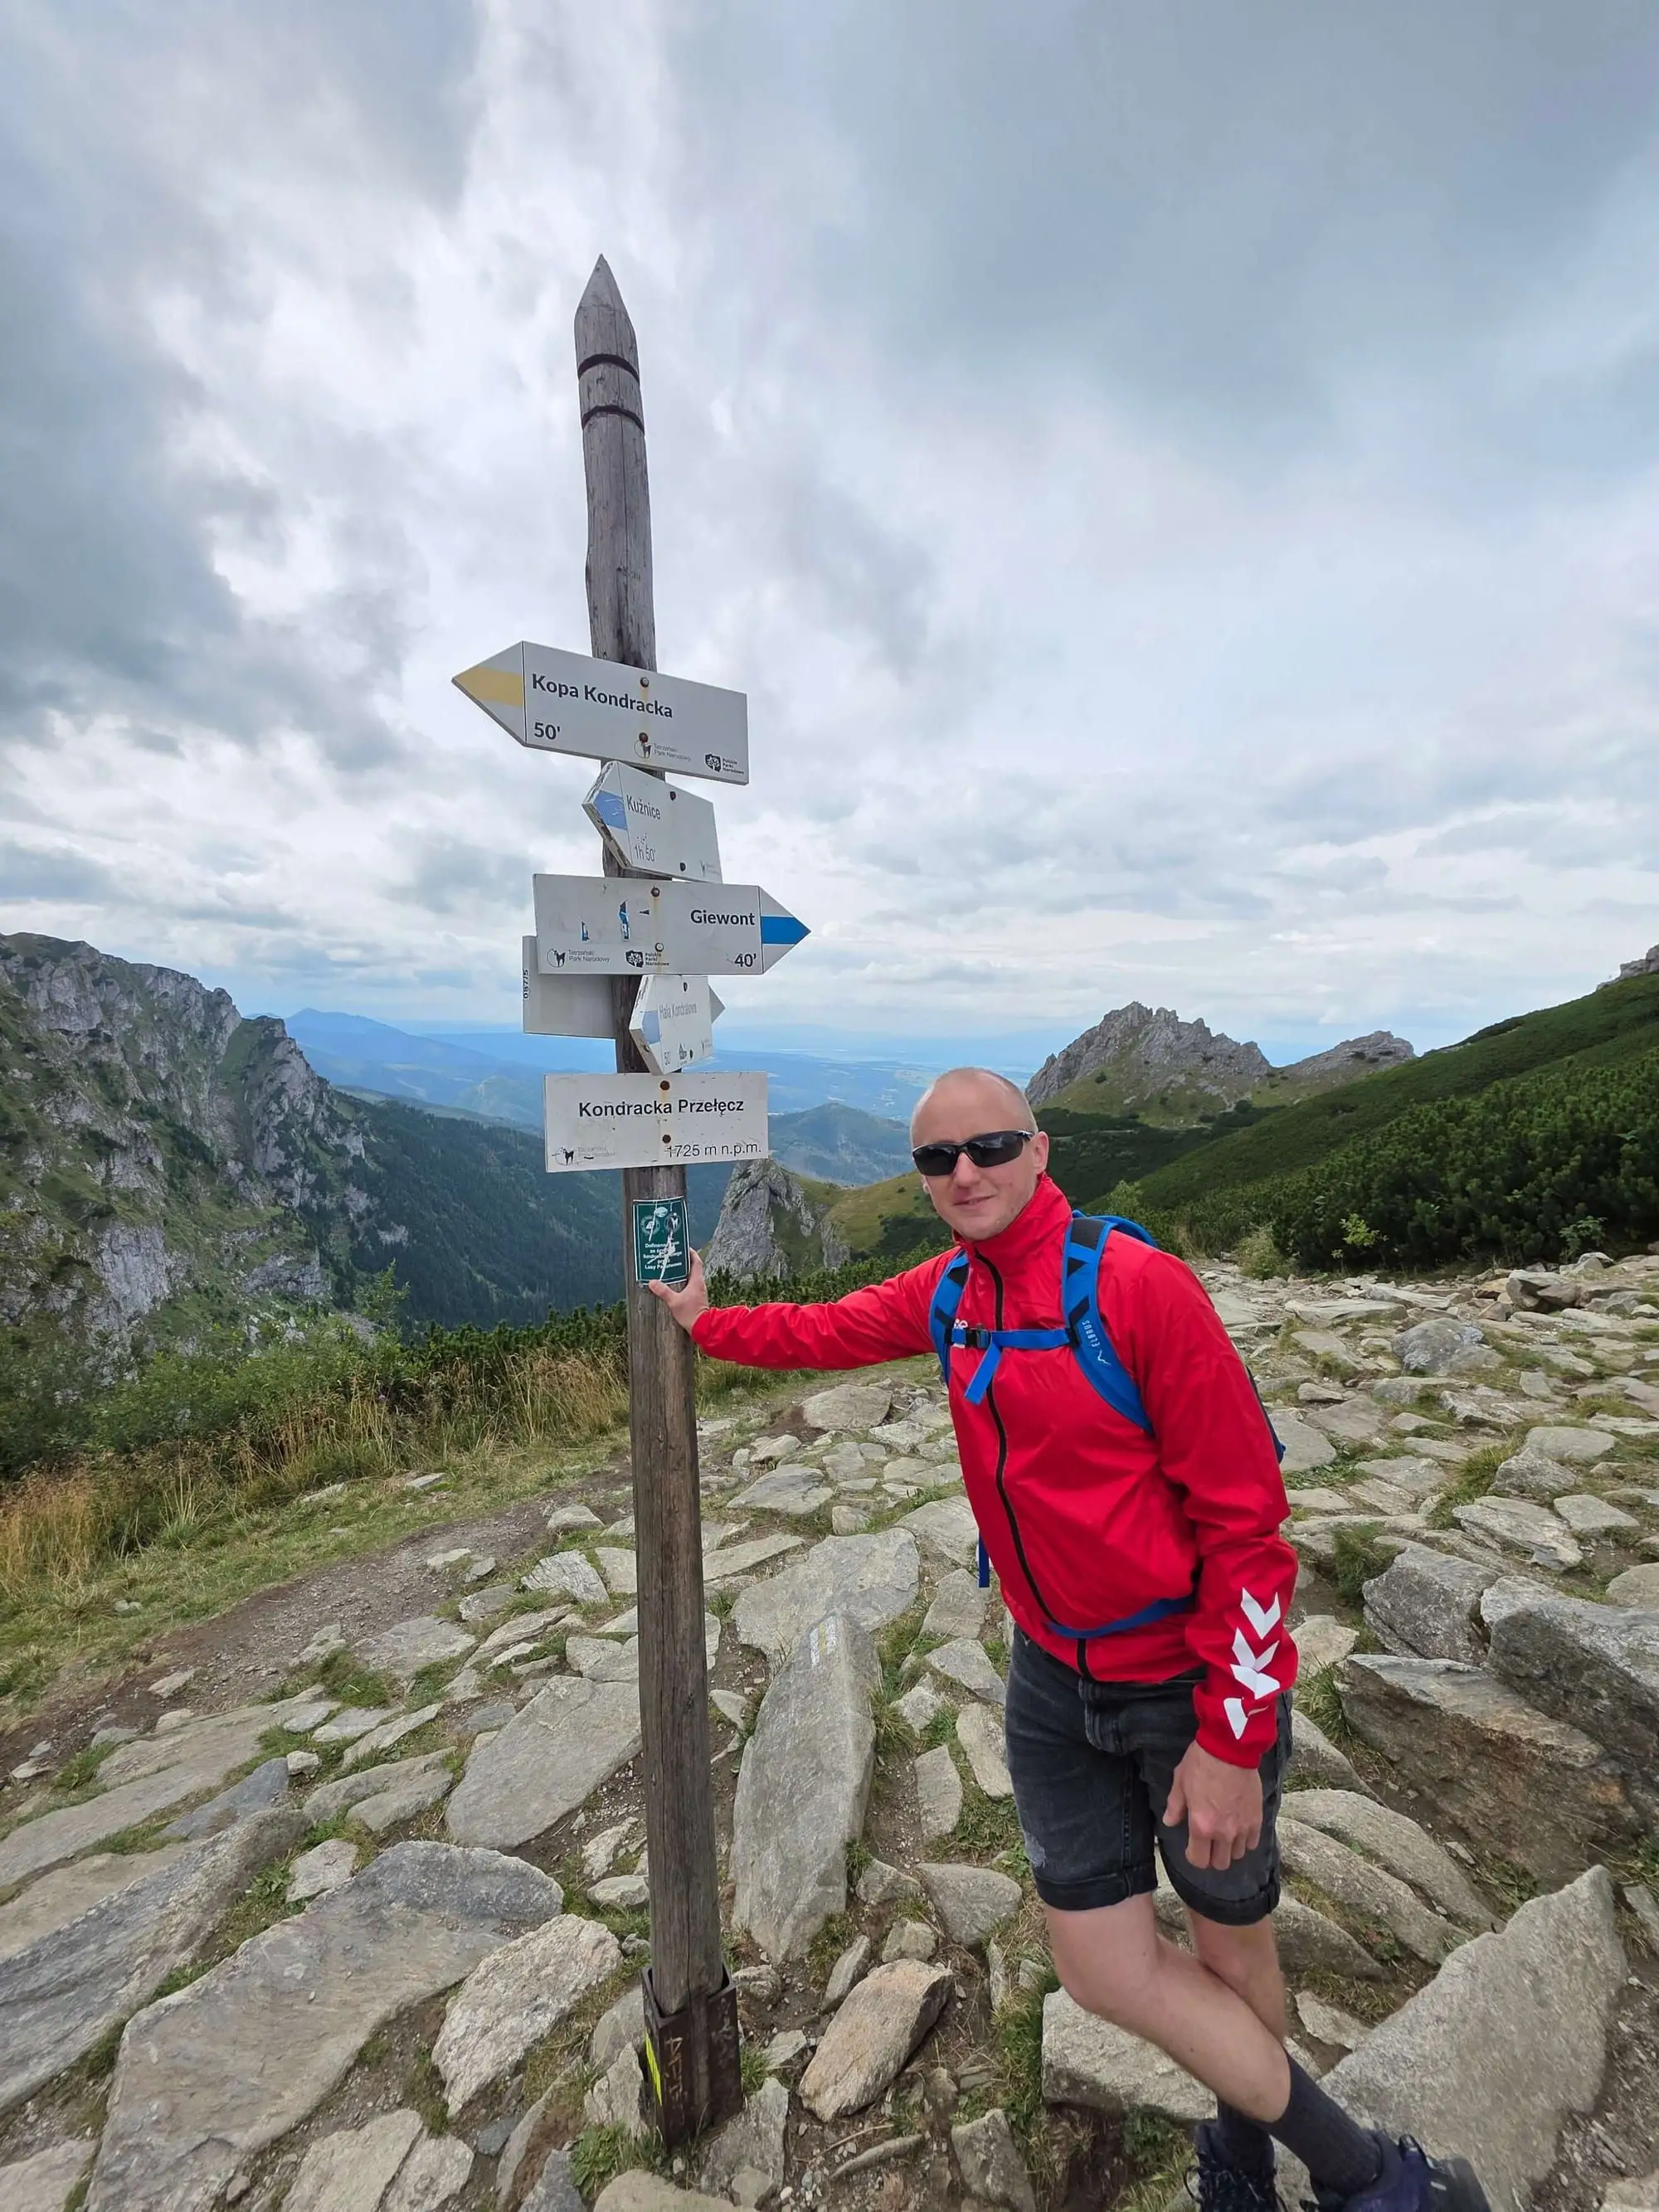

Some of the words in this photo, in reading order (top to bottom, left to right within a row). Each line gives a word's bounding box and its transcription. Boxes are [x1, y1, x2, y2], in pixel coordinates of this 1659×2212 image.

[532, 673, 579, 698] Kopa
[584, 685, 673, 718] Kondracka
[533, 722, 560, 740] 50'
[635, 846, 645, 860] 1h
[691, 909, 755, 926] Giewont
[734, 953, 757, 968] 40'
[579, 1101, 672, 1117] Kondracka
[678, 1098, 744, 1116] Przełęcz
[667, 1144, 700, 1158] 1725
[704, 1145, 717, 1155] m
[721, 1142, 761, 1156] n.p.m.
